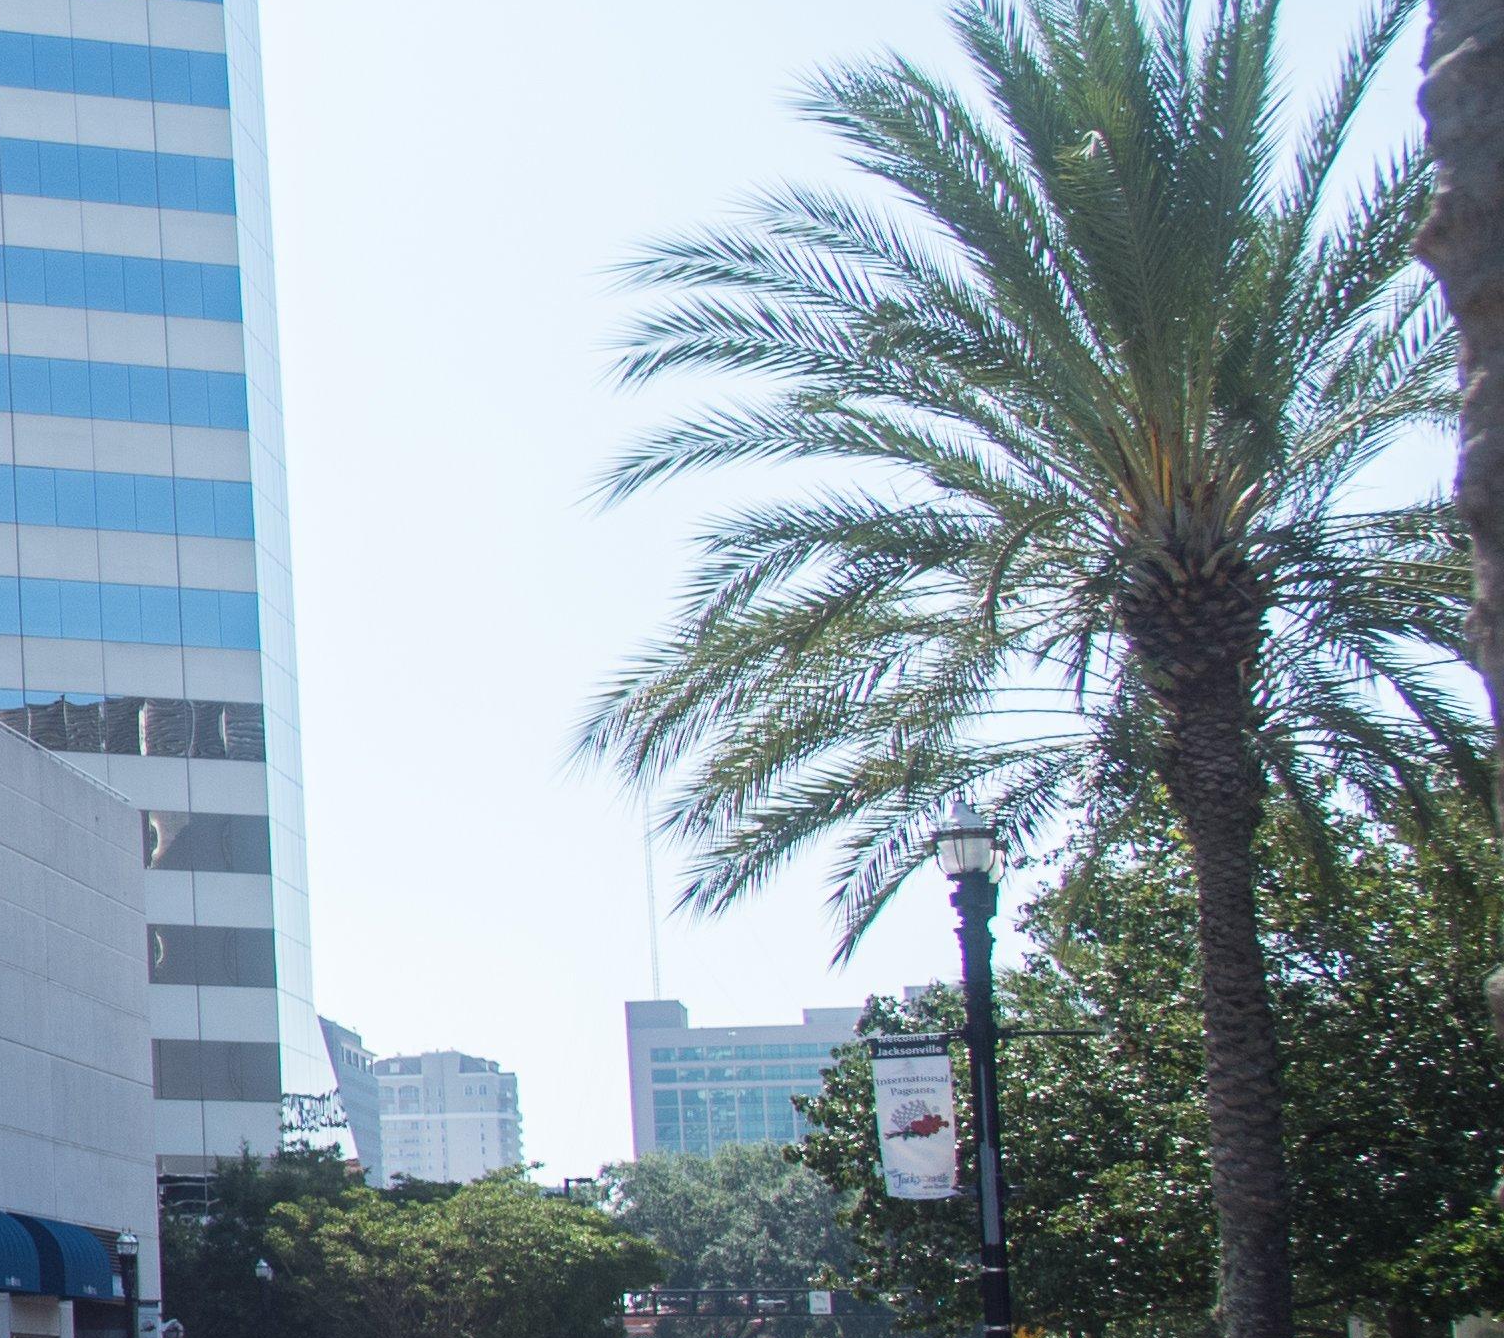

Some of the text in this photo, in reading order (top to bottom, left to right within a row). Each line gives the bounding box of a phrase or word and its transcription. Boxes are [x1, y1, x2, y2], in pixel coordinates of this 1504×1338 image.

[877, 1045, 944, 1056] Jacksonville
[876, 1075, 948, 1086] International
[890, 1088, 936, 1096] Pageants
